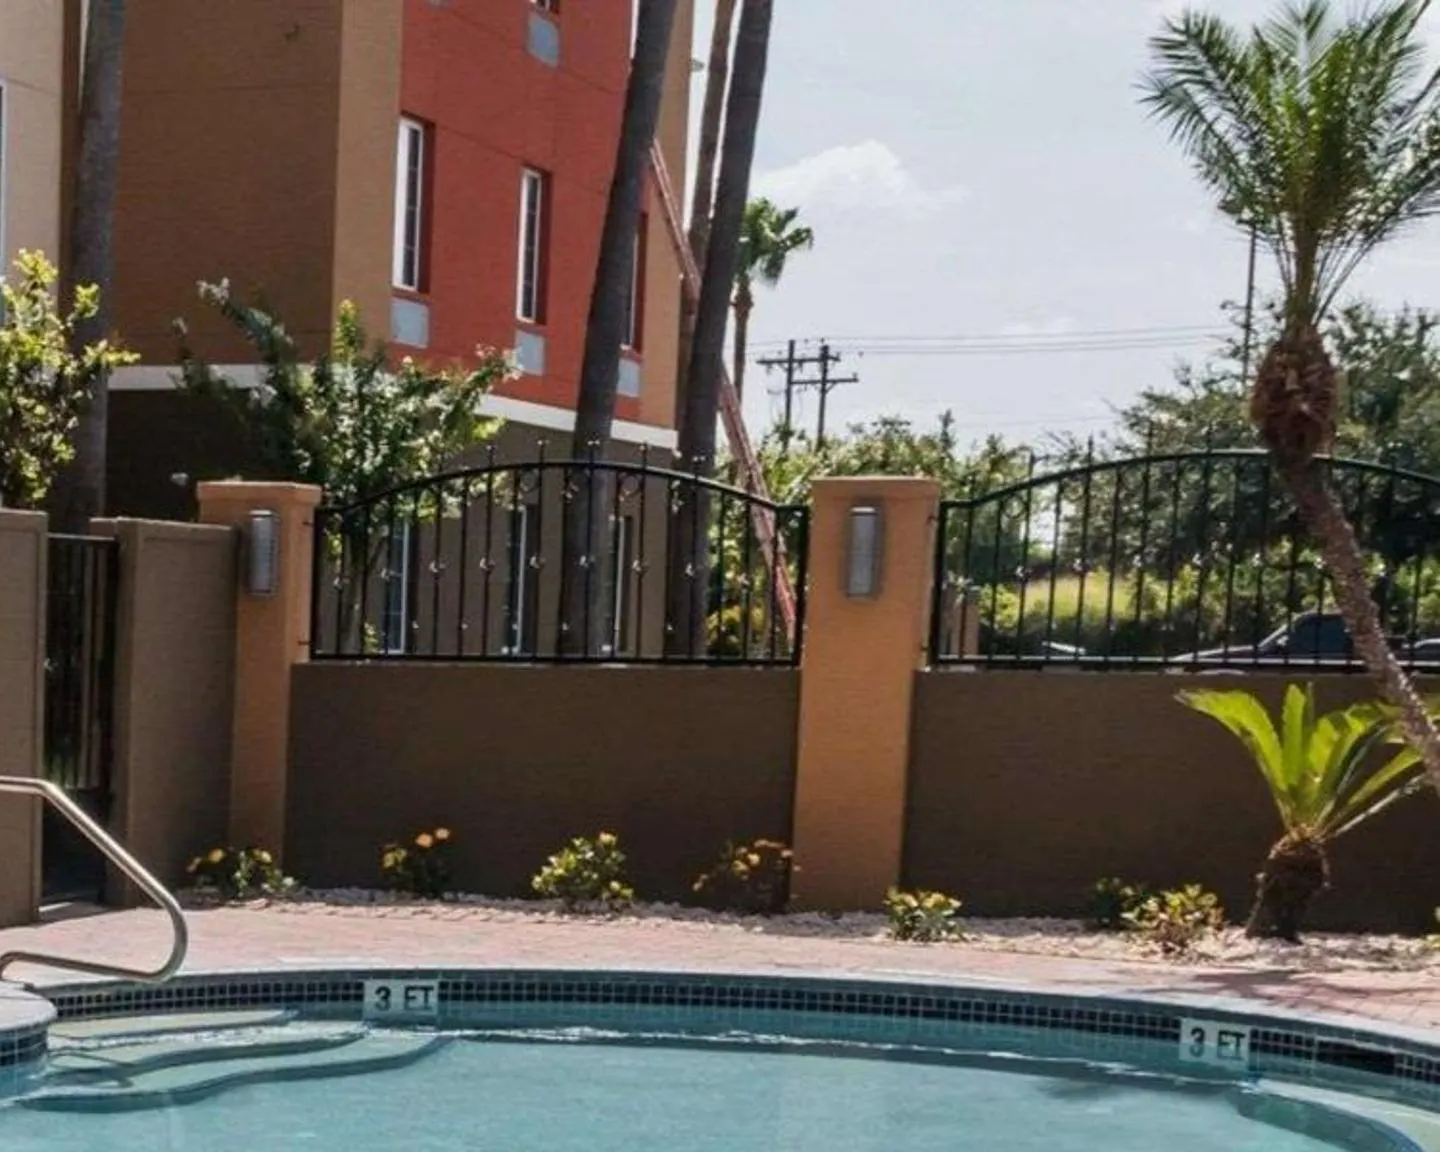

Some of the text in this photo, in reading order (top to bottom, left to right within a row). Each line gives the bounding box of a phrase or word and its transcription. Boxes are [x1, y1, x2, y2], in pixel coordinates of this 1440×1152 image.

[374, 985, 435, 1011] 3 FT
[1190, 1026, 1246, 1057] 3 FT
